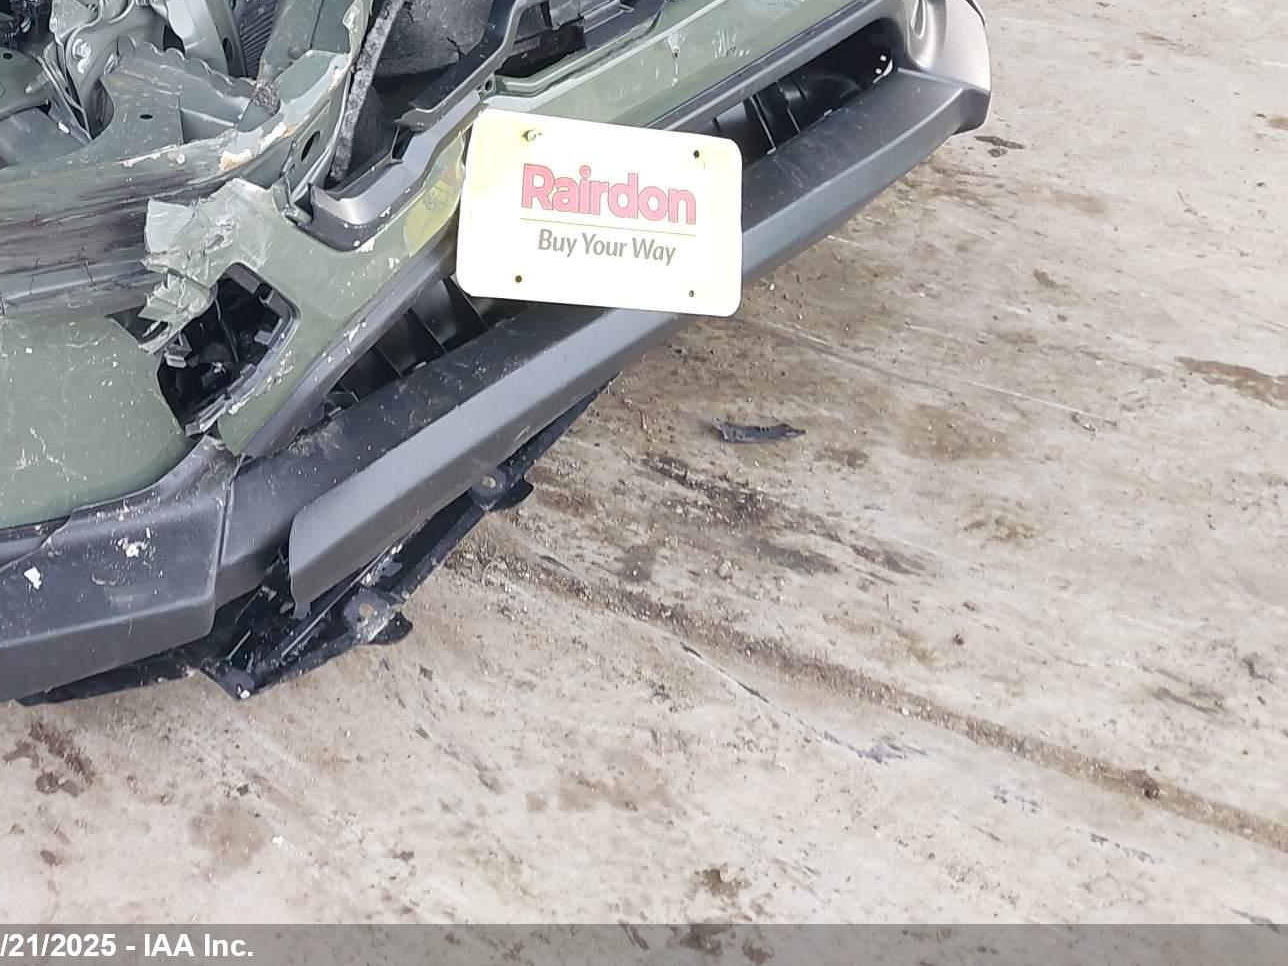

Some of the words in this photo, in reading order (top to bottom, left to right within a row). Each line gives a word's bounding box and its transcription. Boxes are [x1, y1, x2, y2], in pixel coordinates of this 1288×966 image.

[521, 163, 697, 225] Rairdon
[537, 228, 578, 257] Buy
[582, 232, 628, 258] Your
[631, 237, 676, 266] Way
